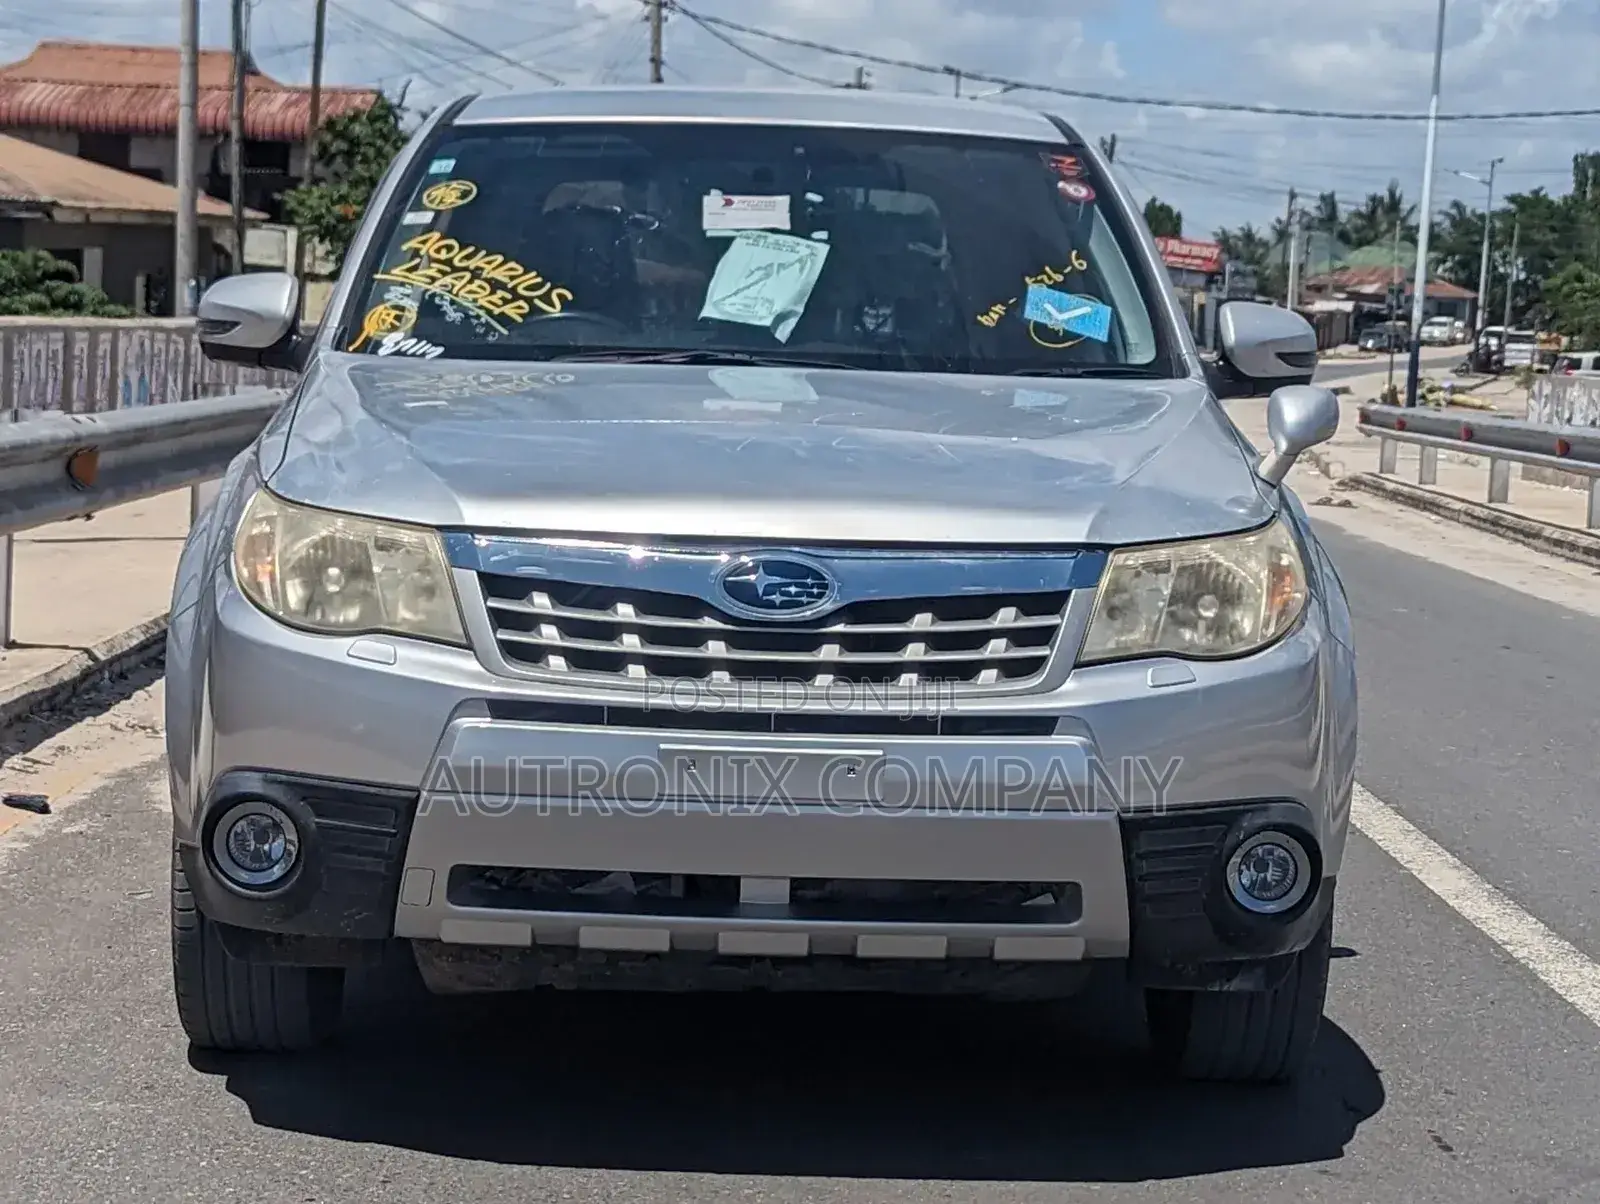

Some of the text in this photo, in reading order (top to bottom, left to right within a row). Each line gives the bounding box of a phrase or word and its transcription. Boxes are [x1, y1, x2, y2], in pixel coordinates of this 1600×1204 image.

[401, 231, 573, 313] AQUARIUS
[1167, 239, 1219, 262] Pharmacy
[390, 258, 530, 323] LEADER
